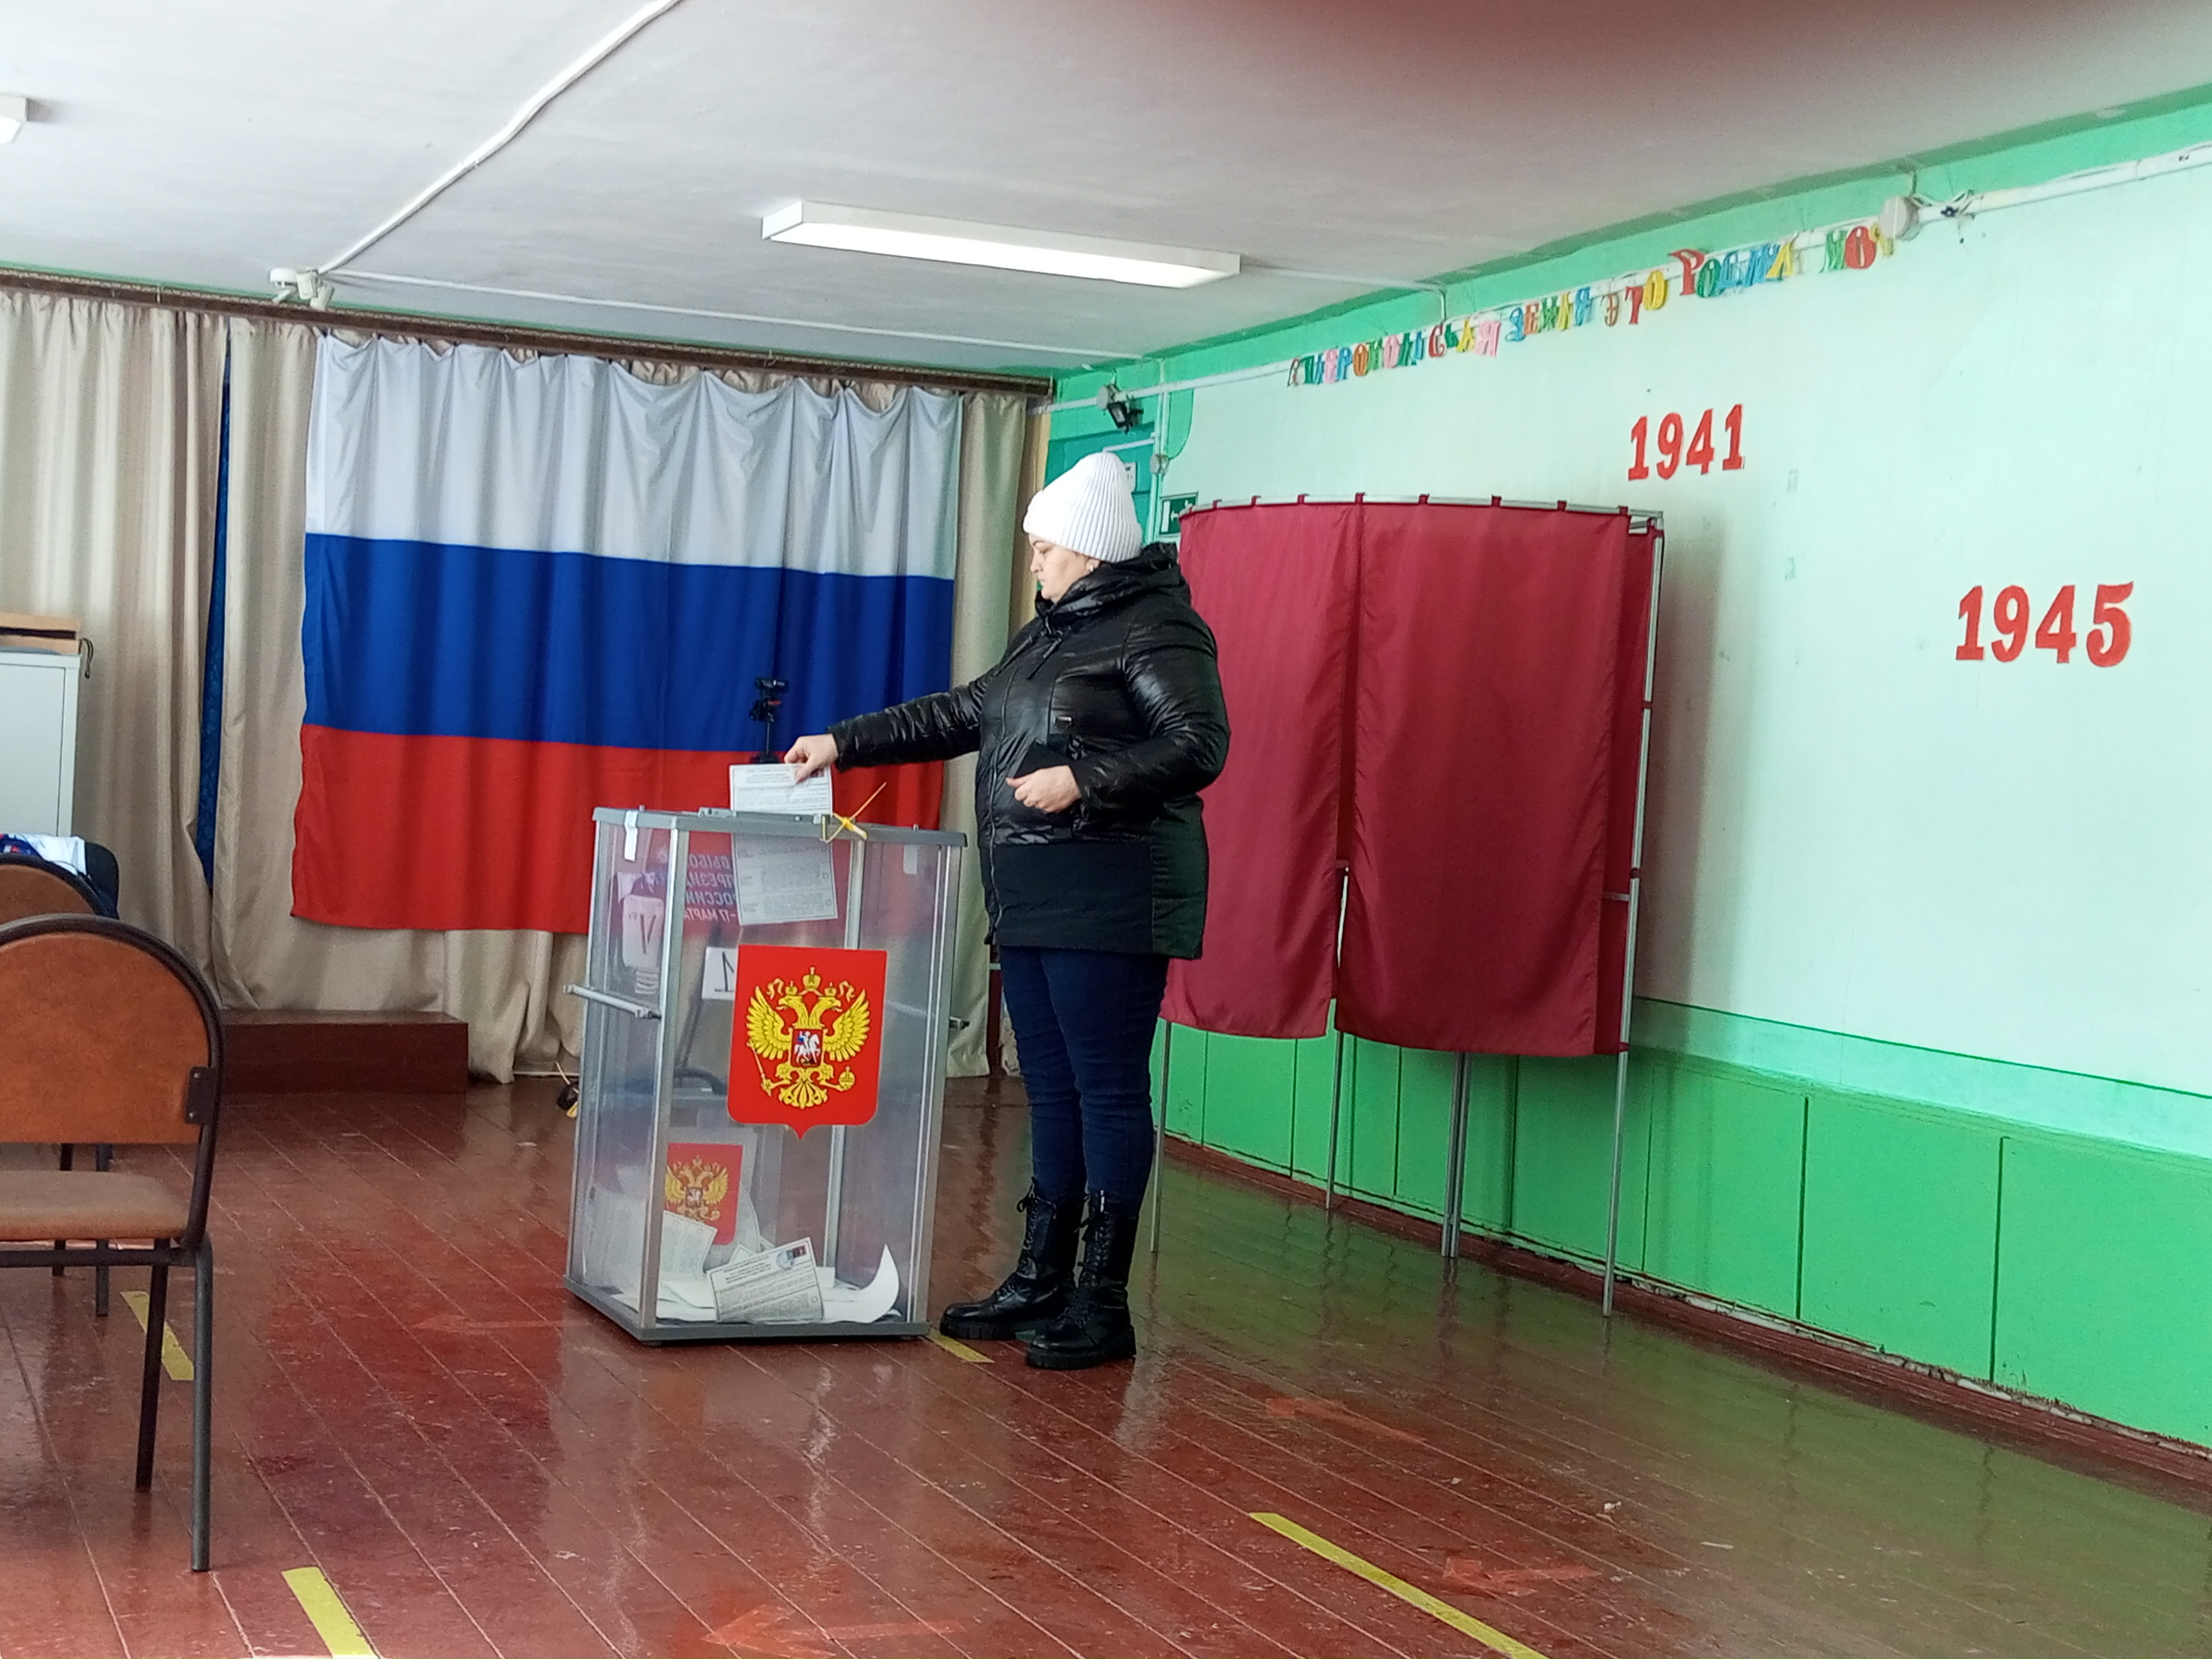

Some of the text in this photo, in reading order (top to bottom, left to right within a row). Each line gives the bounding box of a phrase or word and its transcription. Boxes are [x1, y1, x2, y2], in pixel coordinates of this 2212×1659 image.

[1601, 270, 1668, 327] ЭТО
[1668, 242, 1793, 297] РОДИНА
[1628, 404, 1744, 481] 1941
[1956, 581, 2134, 667] 1945
